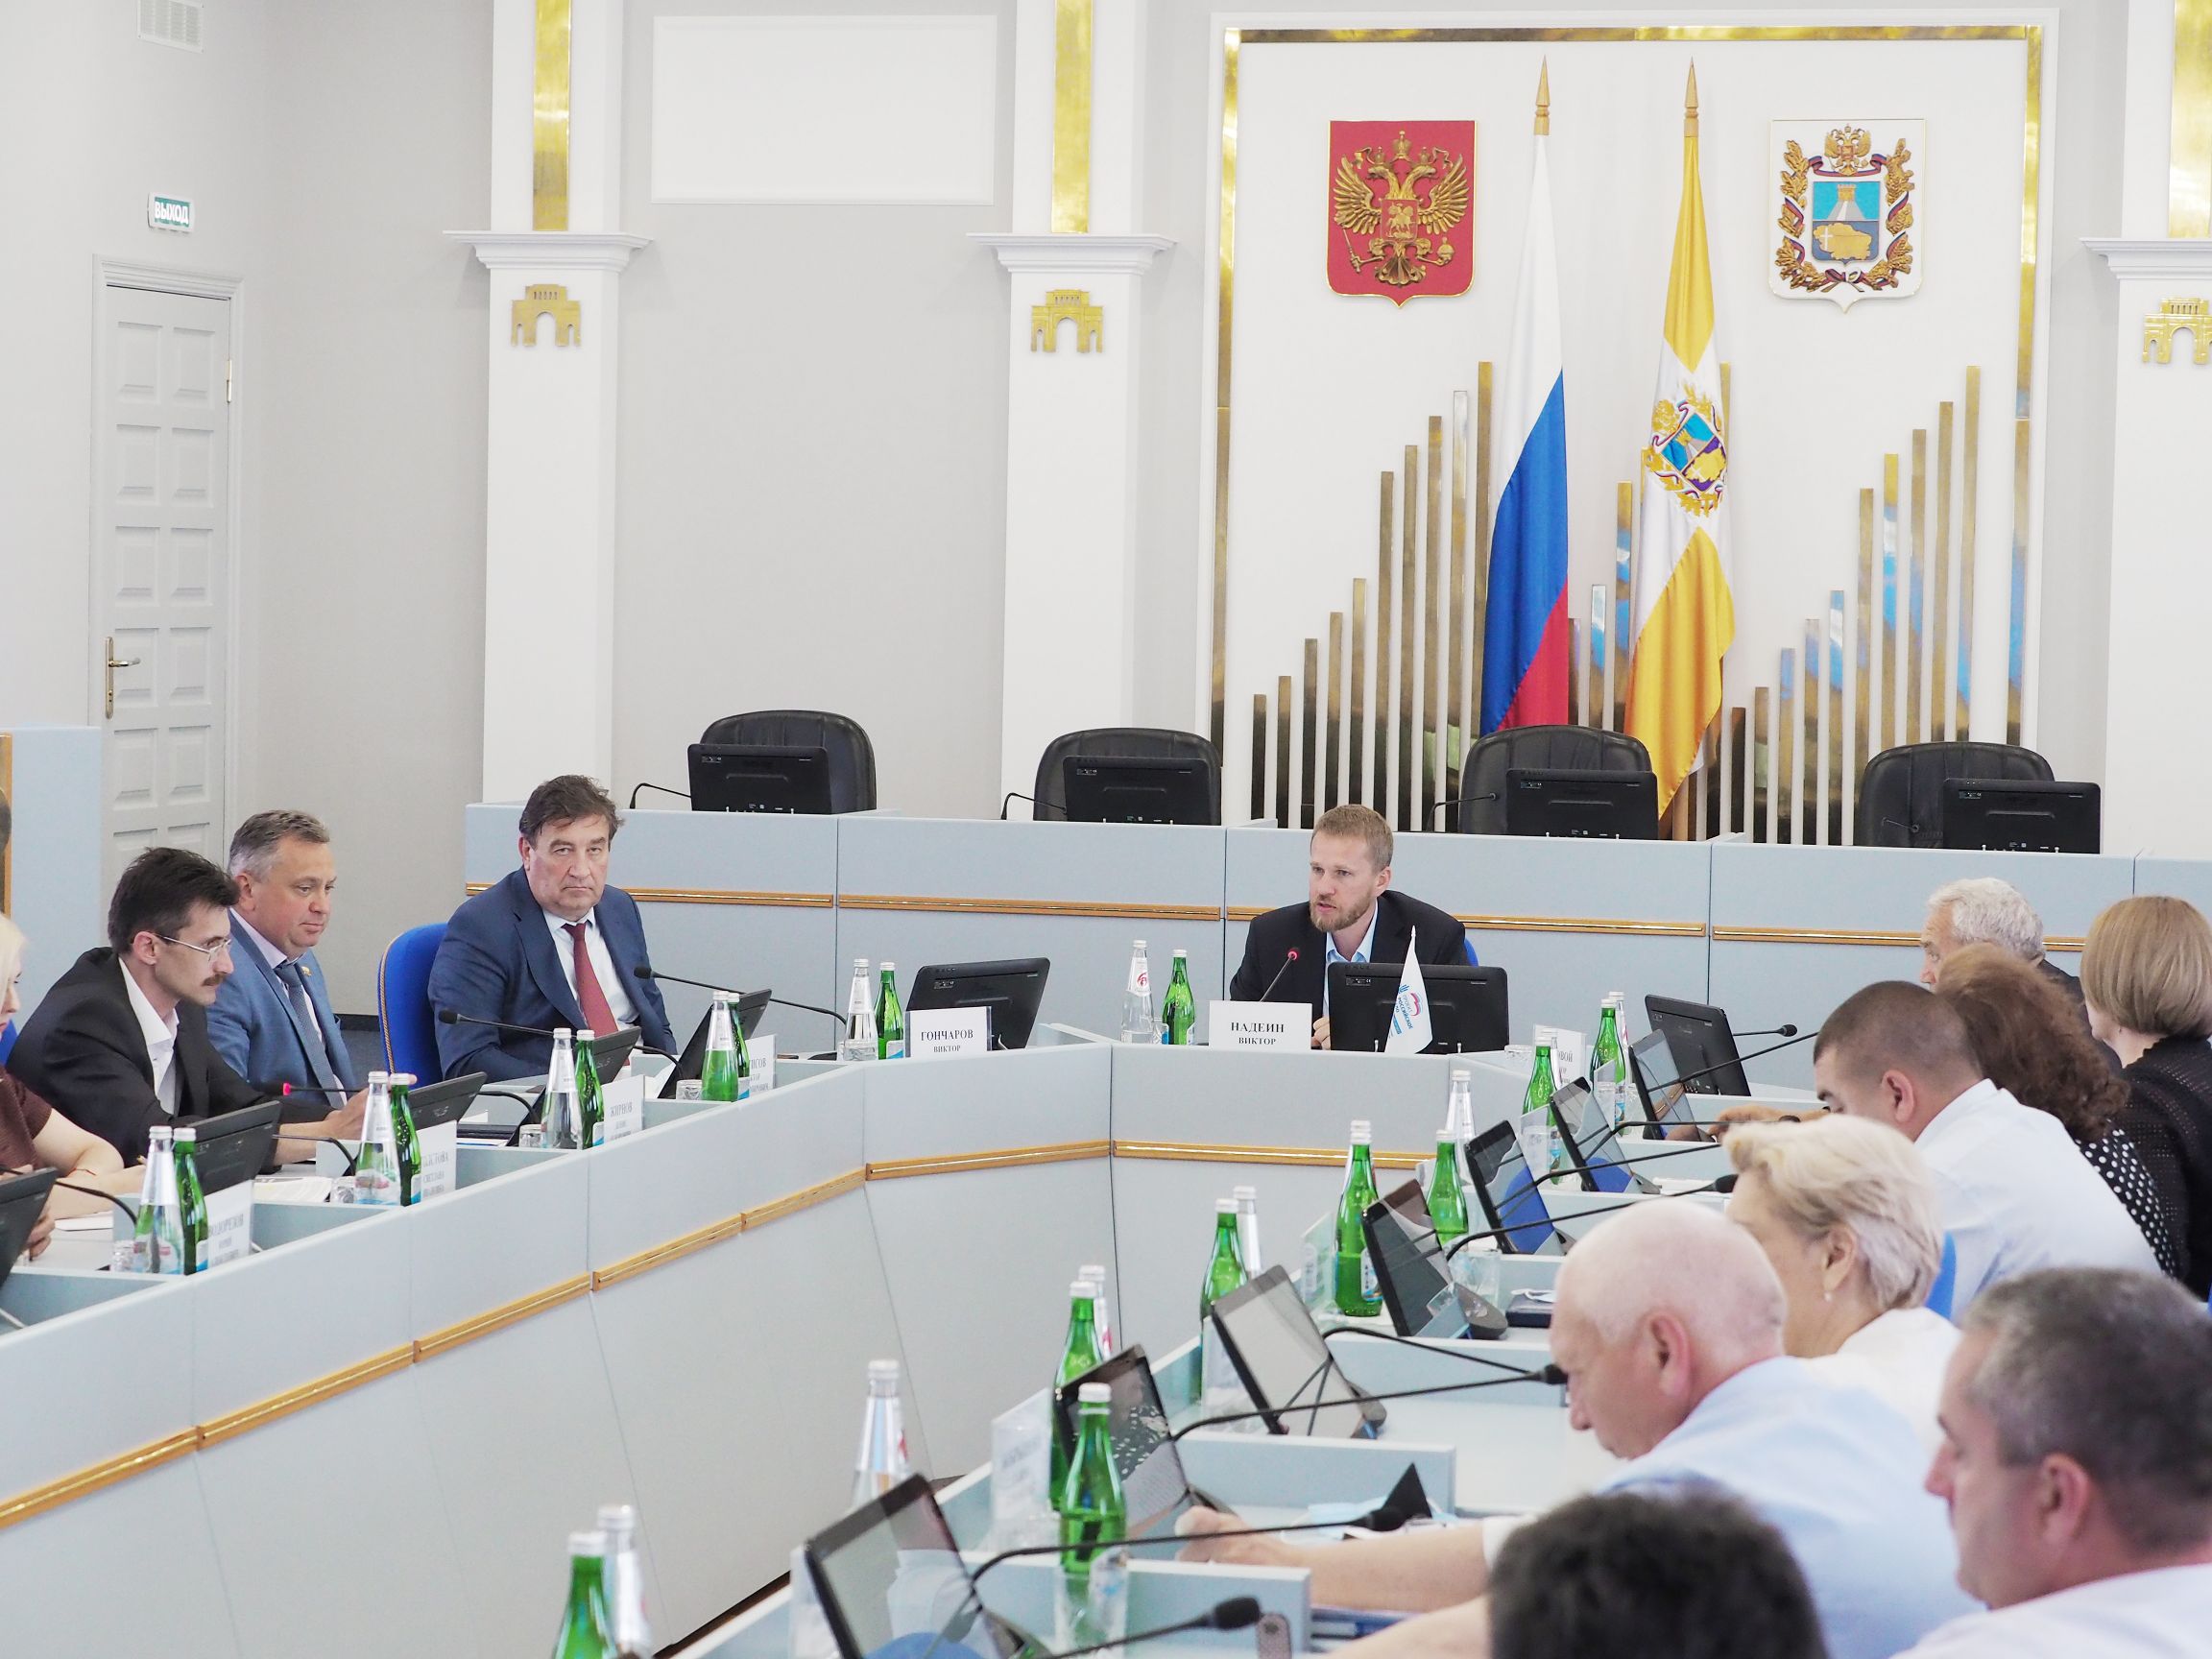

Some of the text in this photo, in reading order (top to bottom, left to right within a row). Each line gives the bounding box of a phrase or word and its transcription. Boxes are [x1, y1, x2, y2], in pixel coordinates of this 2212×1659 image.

[155, 202, 189, 225] ВЫХОД
[1231, 1022, 1285, 1034] НАДЕИН
[921, 1029, 974, 1042] ГОНЧАРОВ
[1238, 1037, 1277, 1046] ВИКТОР
[933, 1045, 961, 1053] ВИКТОР
